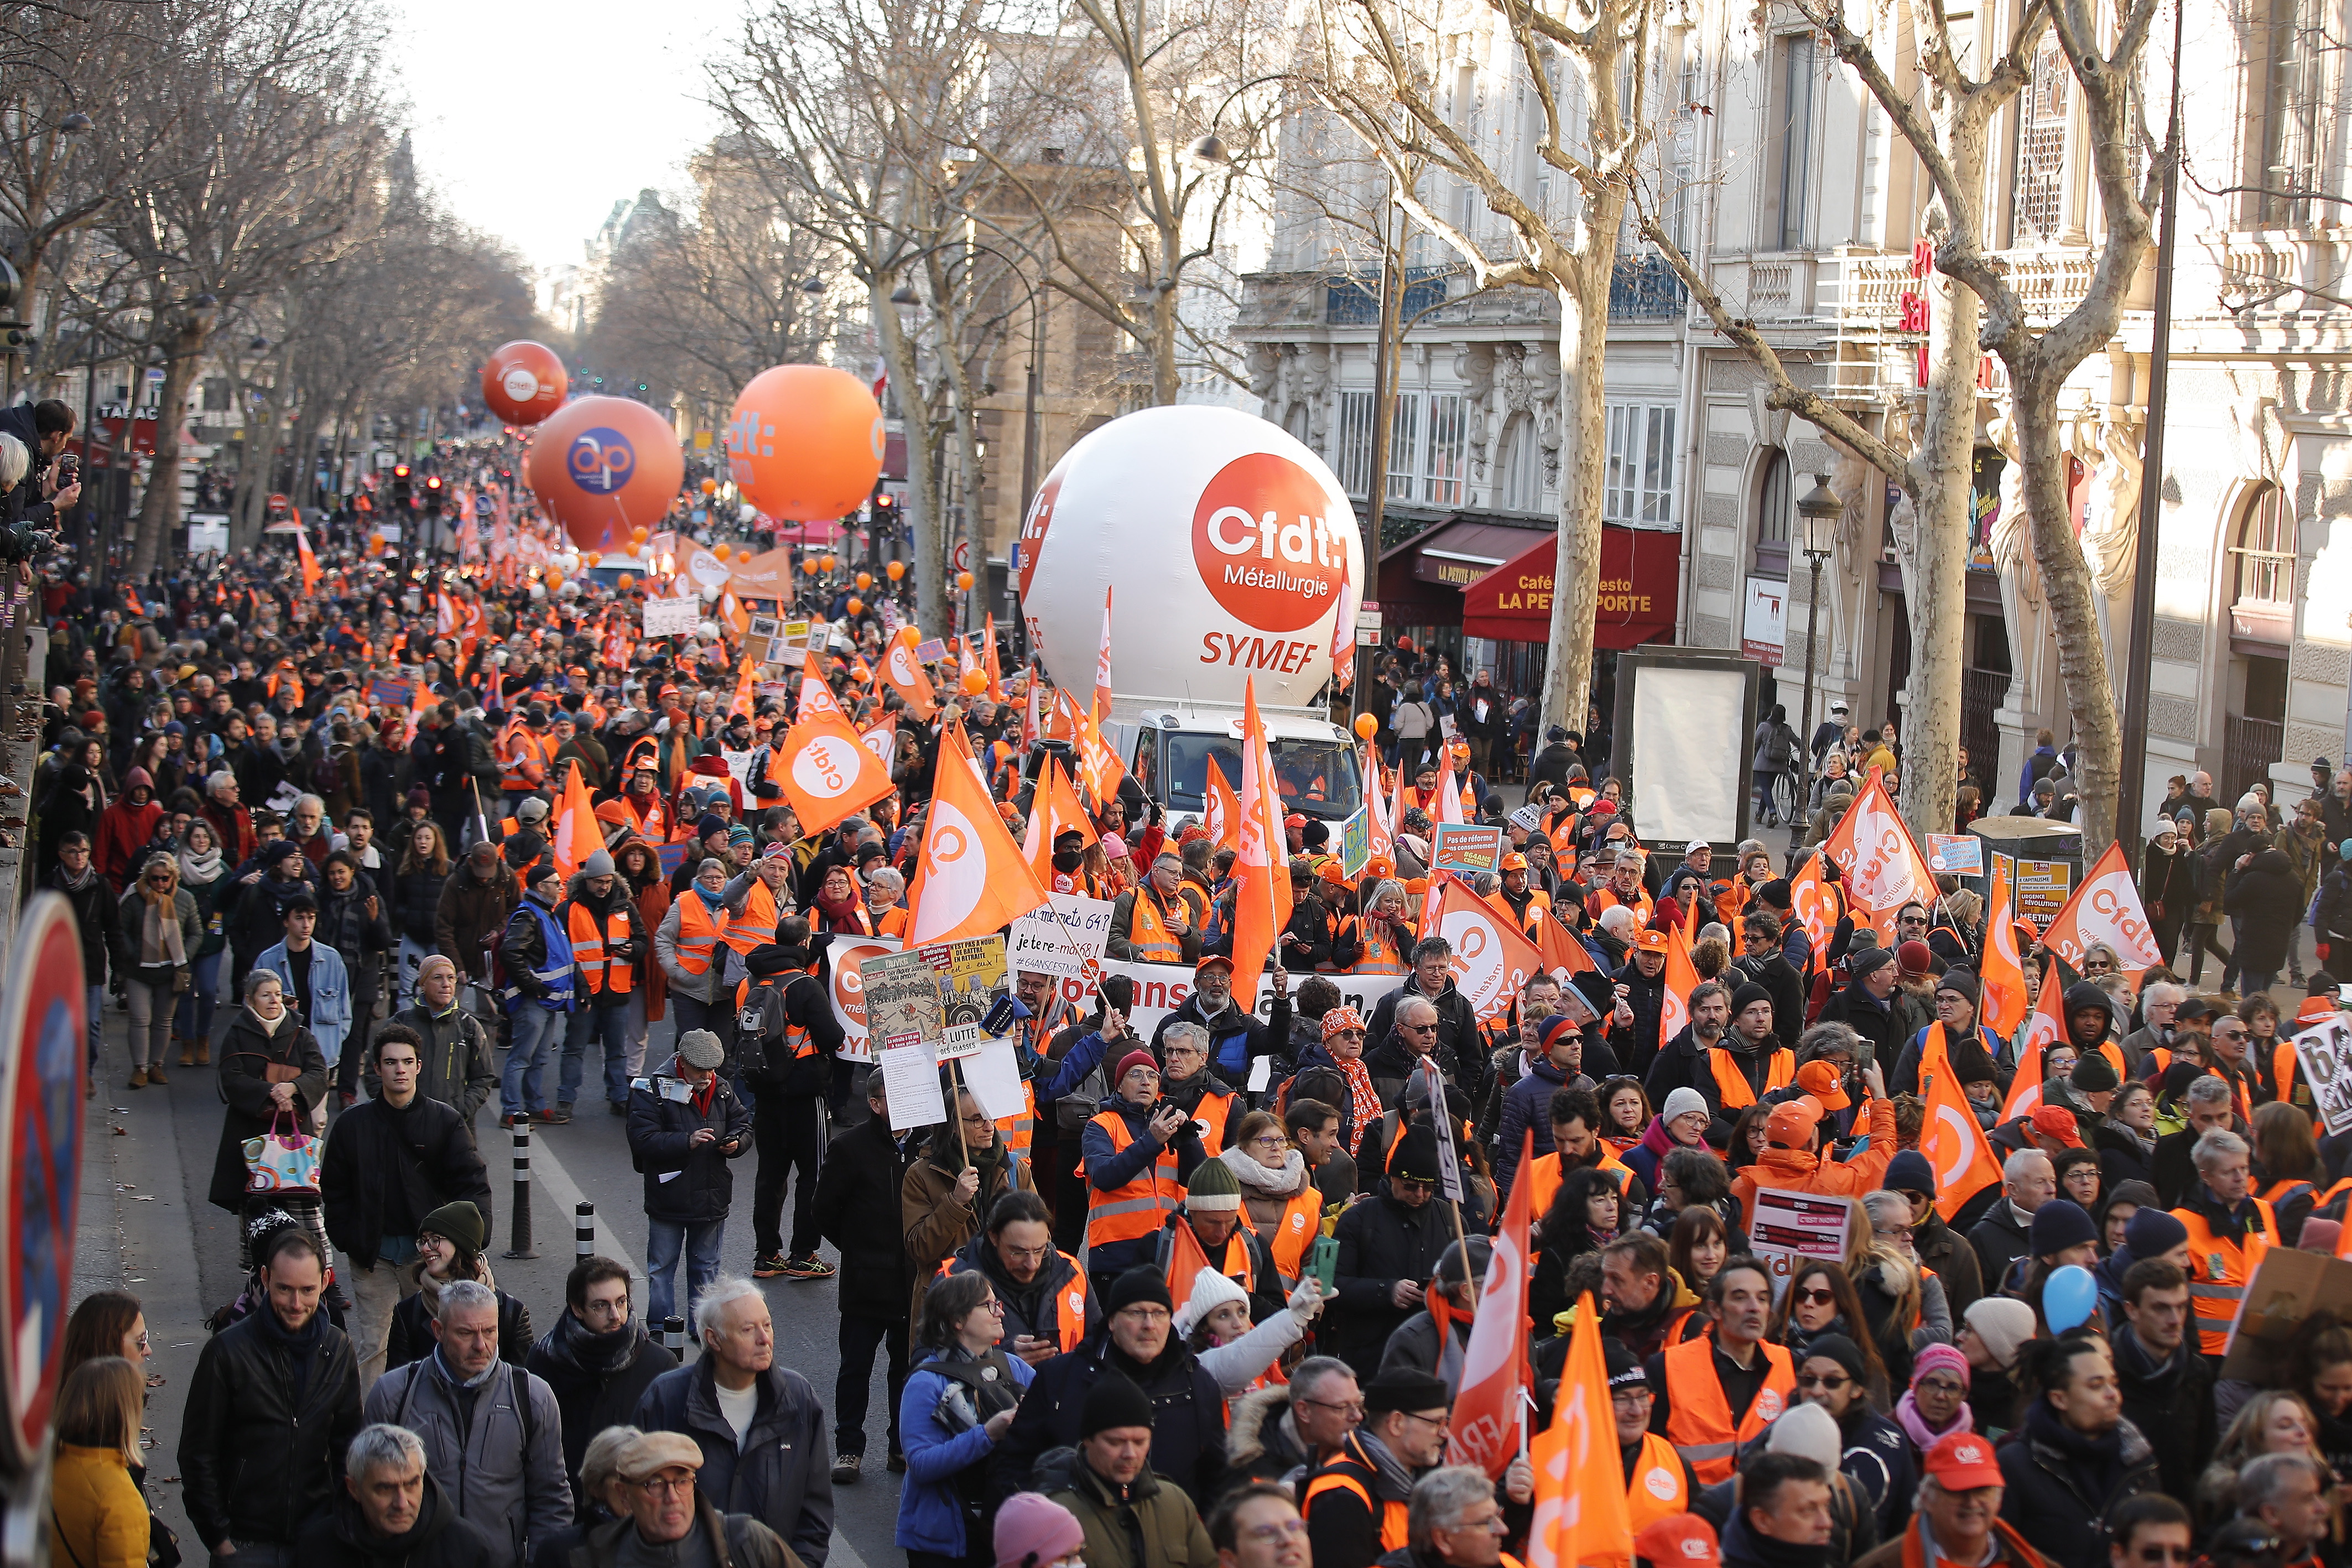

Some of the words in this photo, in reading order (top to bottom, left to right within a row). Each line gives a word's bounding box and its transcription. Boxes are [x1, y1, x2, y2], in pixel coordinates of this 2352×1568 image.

[730, 411, 775, 457] dt:
[1207, 506, 1341, 569] Cfdt:
[1438, 565, 1446, 580] LA
[1448, 567, 1469, 584] PETITE
[1225, 563, 1328, 598] Métallurgie
[1518, 575, 1631, 592] Café-esto
[1498, 593, 1522, 610] LA
[1200, 632, 1318, 675] SYMEF
[1447, 836, 1459, 844] Pas
[1457, 842, 1497, 851] consentement
[1438, 852, 1453, 861] Cfdt:
[1464, 851, 1492, 862] #64ANS
[1463, 858, 1489, 867] CESTNON
[950, 941, 965, 950] N'EST
[1016, 933, 1028, 951] je
[923, 947, 948, 956] Retraites
[964, 946, 983, 955] BATTRE
[885, 957, 908, 968] PAUVRE
[933, 957, 950, 967] endum
[961, 952, 986, 962] RETRAITE
[989, 1003, 1013, 1034] CAPITALISME
[950, 1027, 976, 1044] LUTTE
[953, 1043, 976, 1053] CLASSES
[1817, 1234, 1839, 1243] POUR
